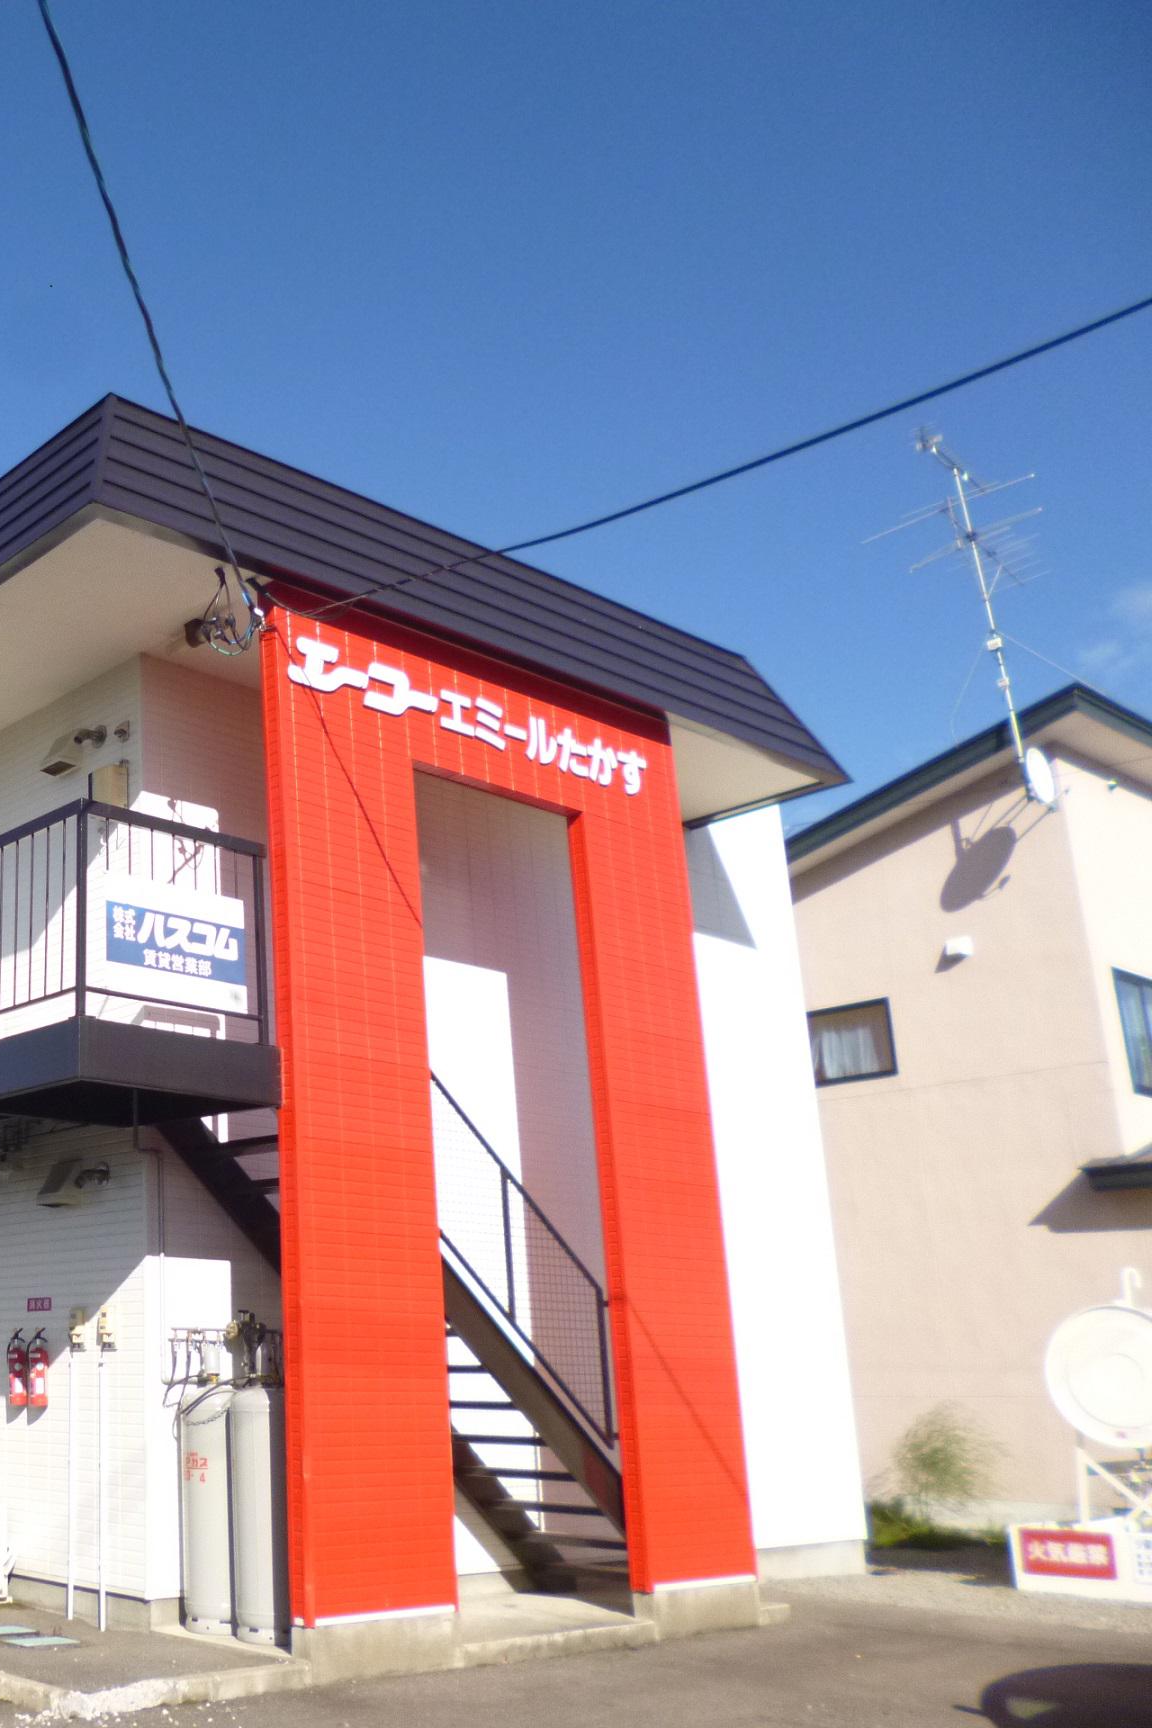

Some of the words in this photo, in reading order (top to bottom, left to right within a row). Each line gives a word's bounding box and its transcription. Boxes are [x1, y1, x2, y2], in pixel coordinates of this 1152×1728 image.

[143, 948, 212, 977] 賃貸営業部
